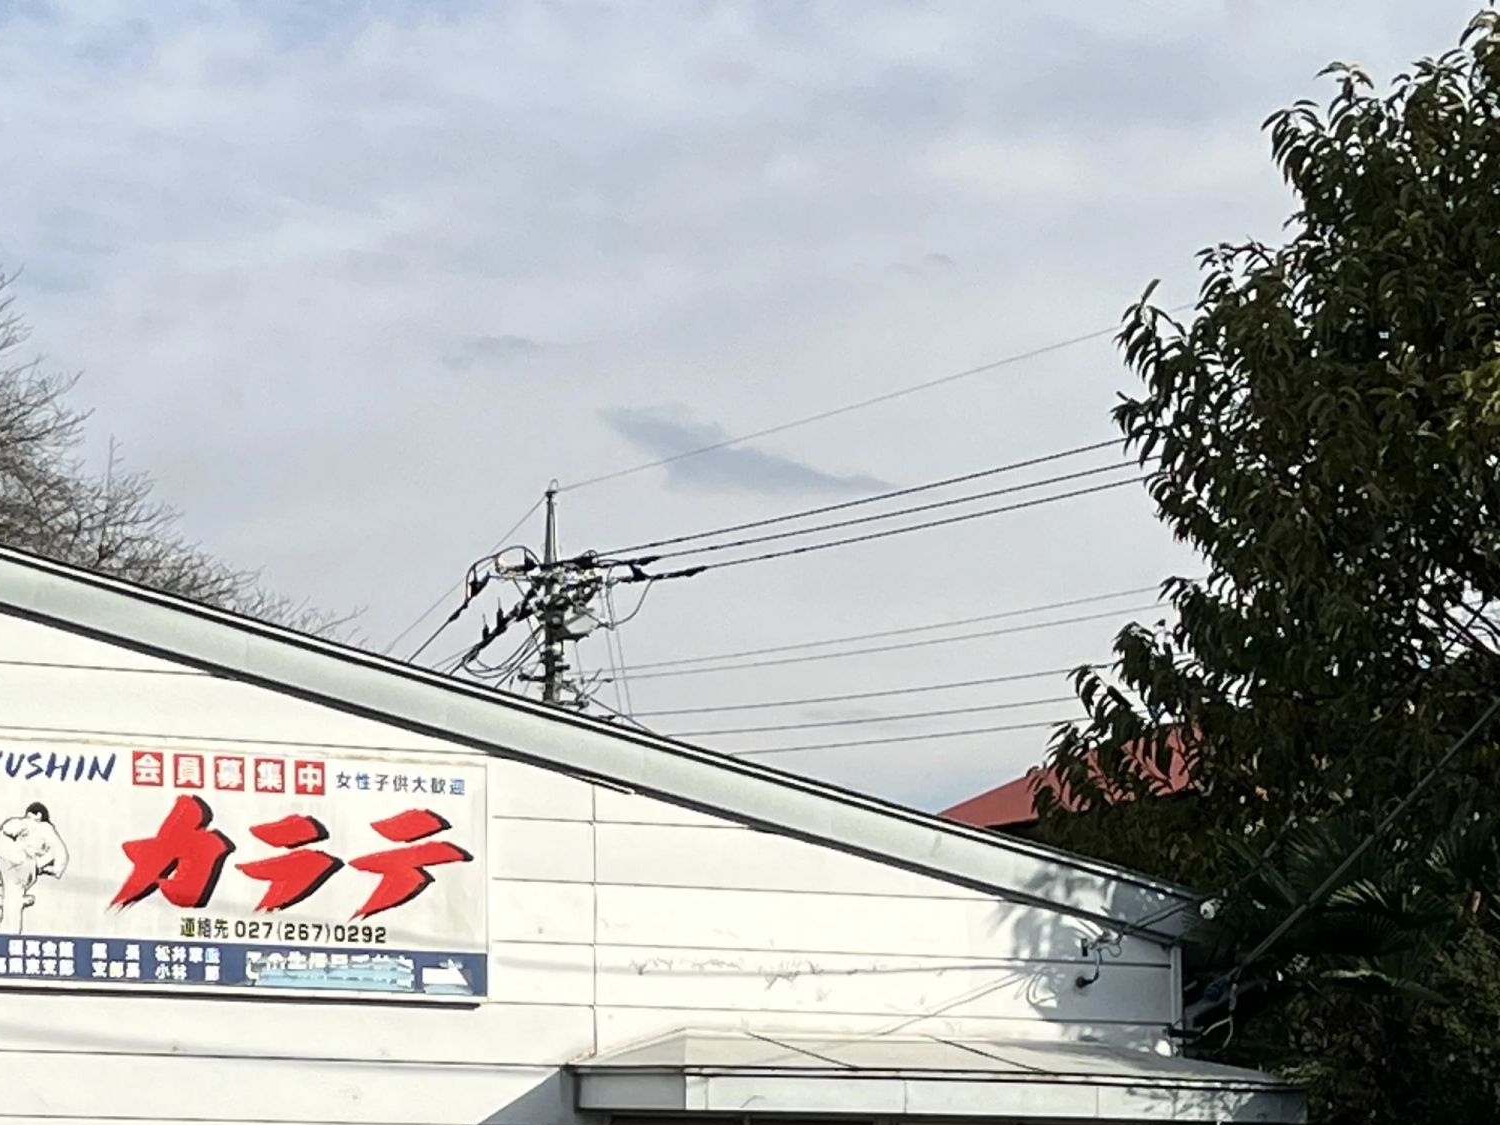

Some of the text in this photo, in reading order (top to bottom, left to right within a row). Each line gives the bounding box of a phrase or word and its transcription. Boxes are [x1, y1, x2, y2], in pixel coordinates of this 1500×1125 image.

[133, 752, 325, 794] 会員募集中
[336, 772, 466, 795] 女性子供大歓迎
[107, 795, 473, 919] カラテ
[180, 917, 387, 943] 連絡先 027(267)0292
